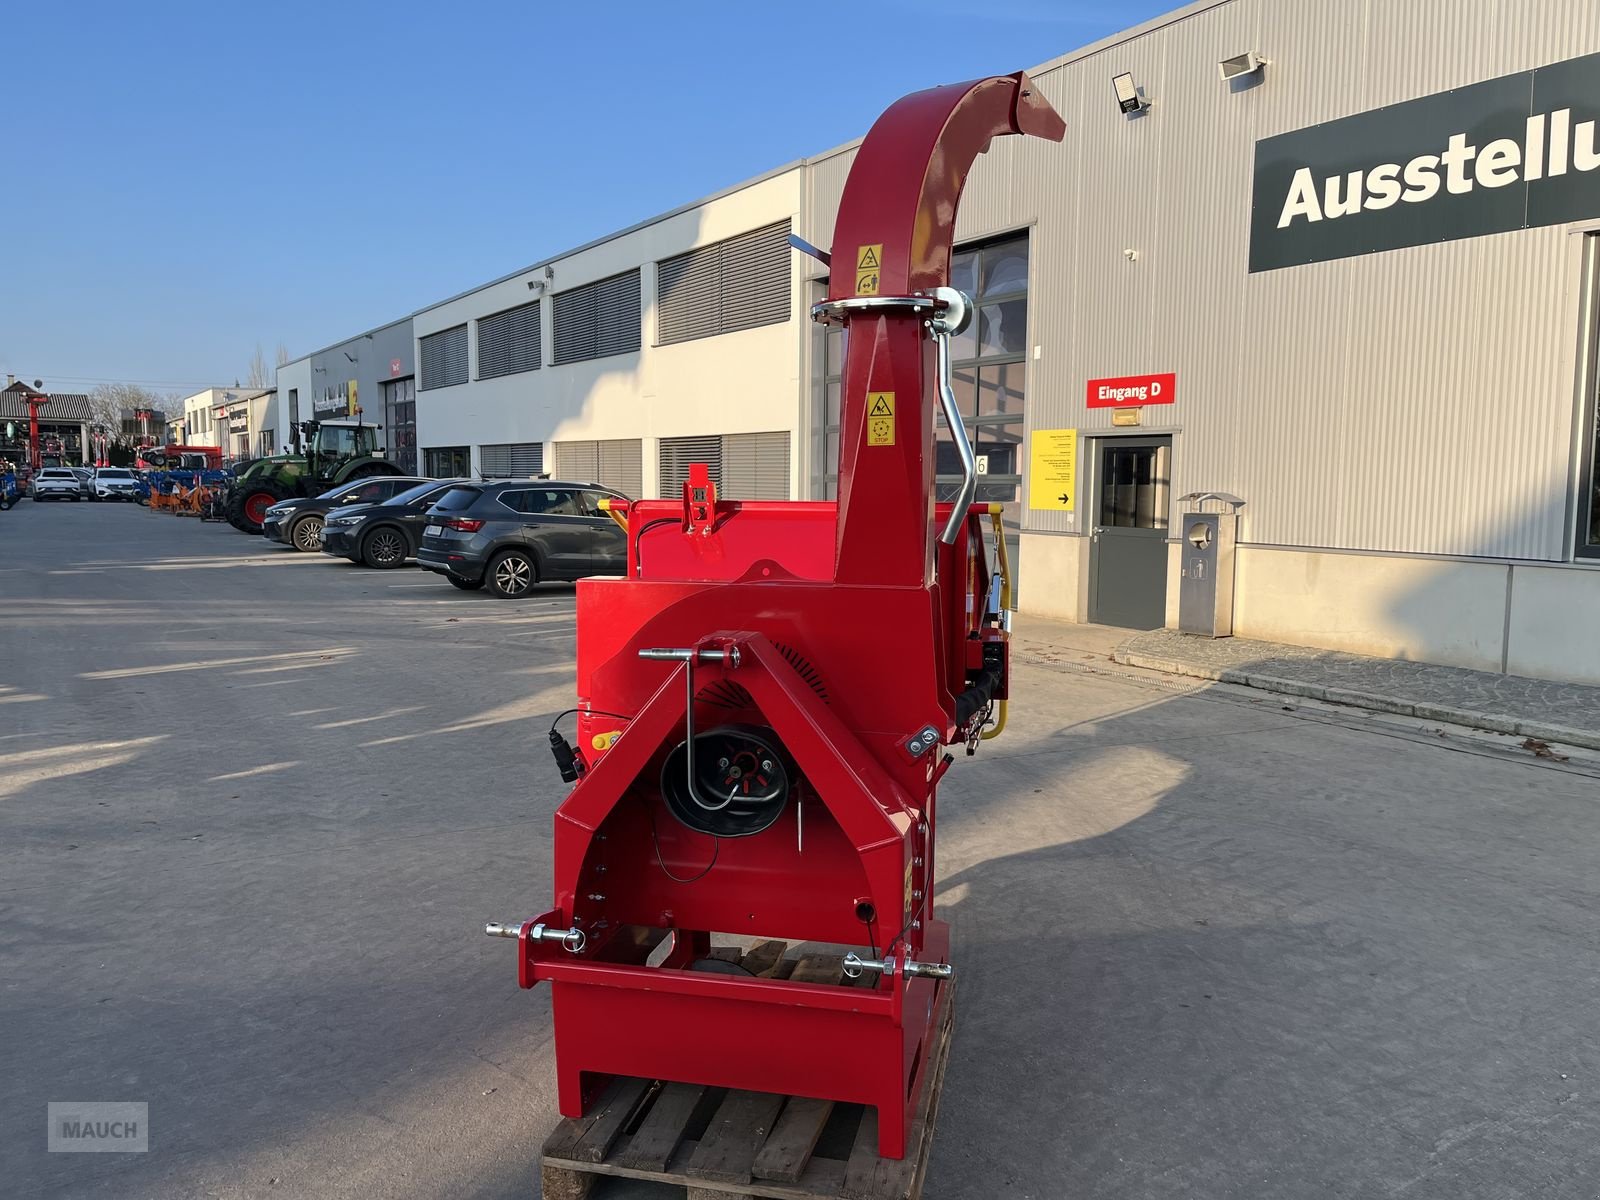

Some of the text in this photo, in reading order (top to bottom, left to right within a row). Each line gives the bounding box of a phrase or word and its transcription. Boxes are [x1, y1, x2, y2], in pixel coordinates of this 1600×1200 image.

[1098, 382, 1161, 401] Eingang D
[978, 458, 985, 473] 6
